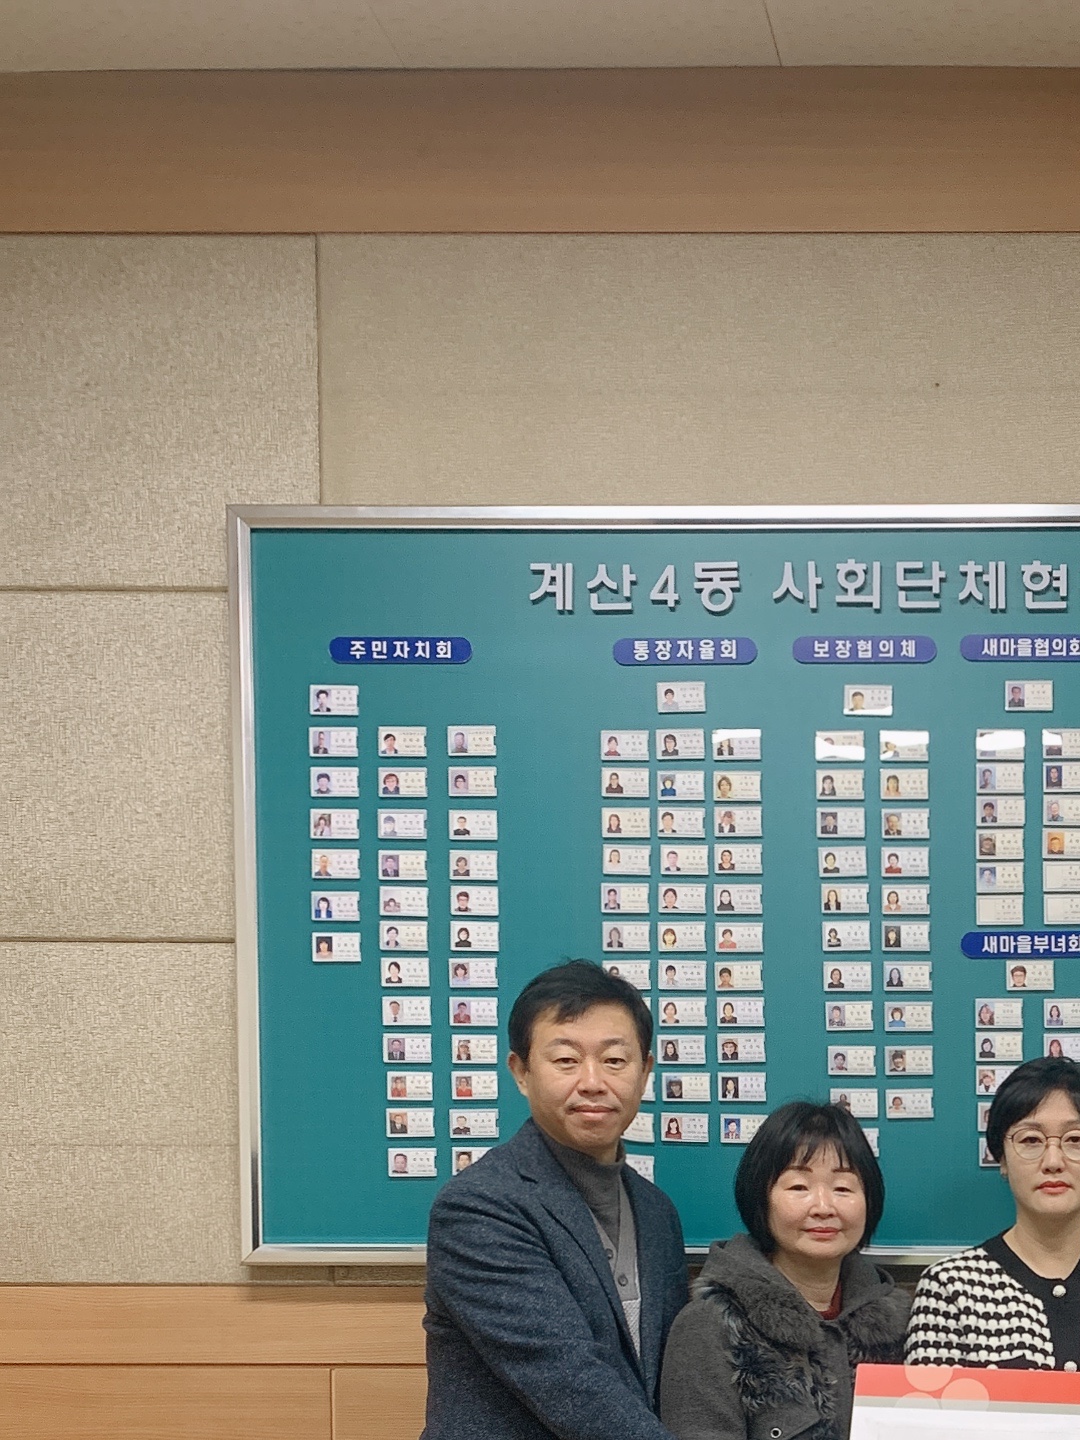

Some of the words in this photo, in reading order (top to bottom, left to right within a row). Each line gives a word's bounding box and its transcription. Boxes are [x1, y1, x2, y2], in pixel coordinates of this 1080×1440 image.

[530, 561, 739, 611] 계산4동
[350, 640, 451, 659] 주민자치회
[634, 639, 736, 660] 통장자율회
[814, 640, 915, 658] 보장협의체
